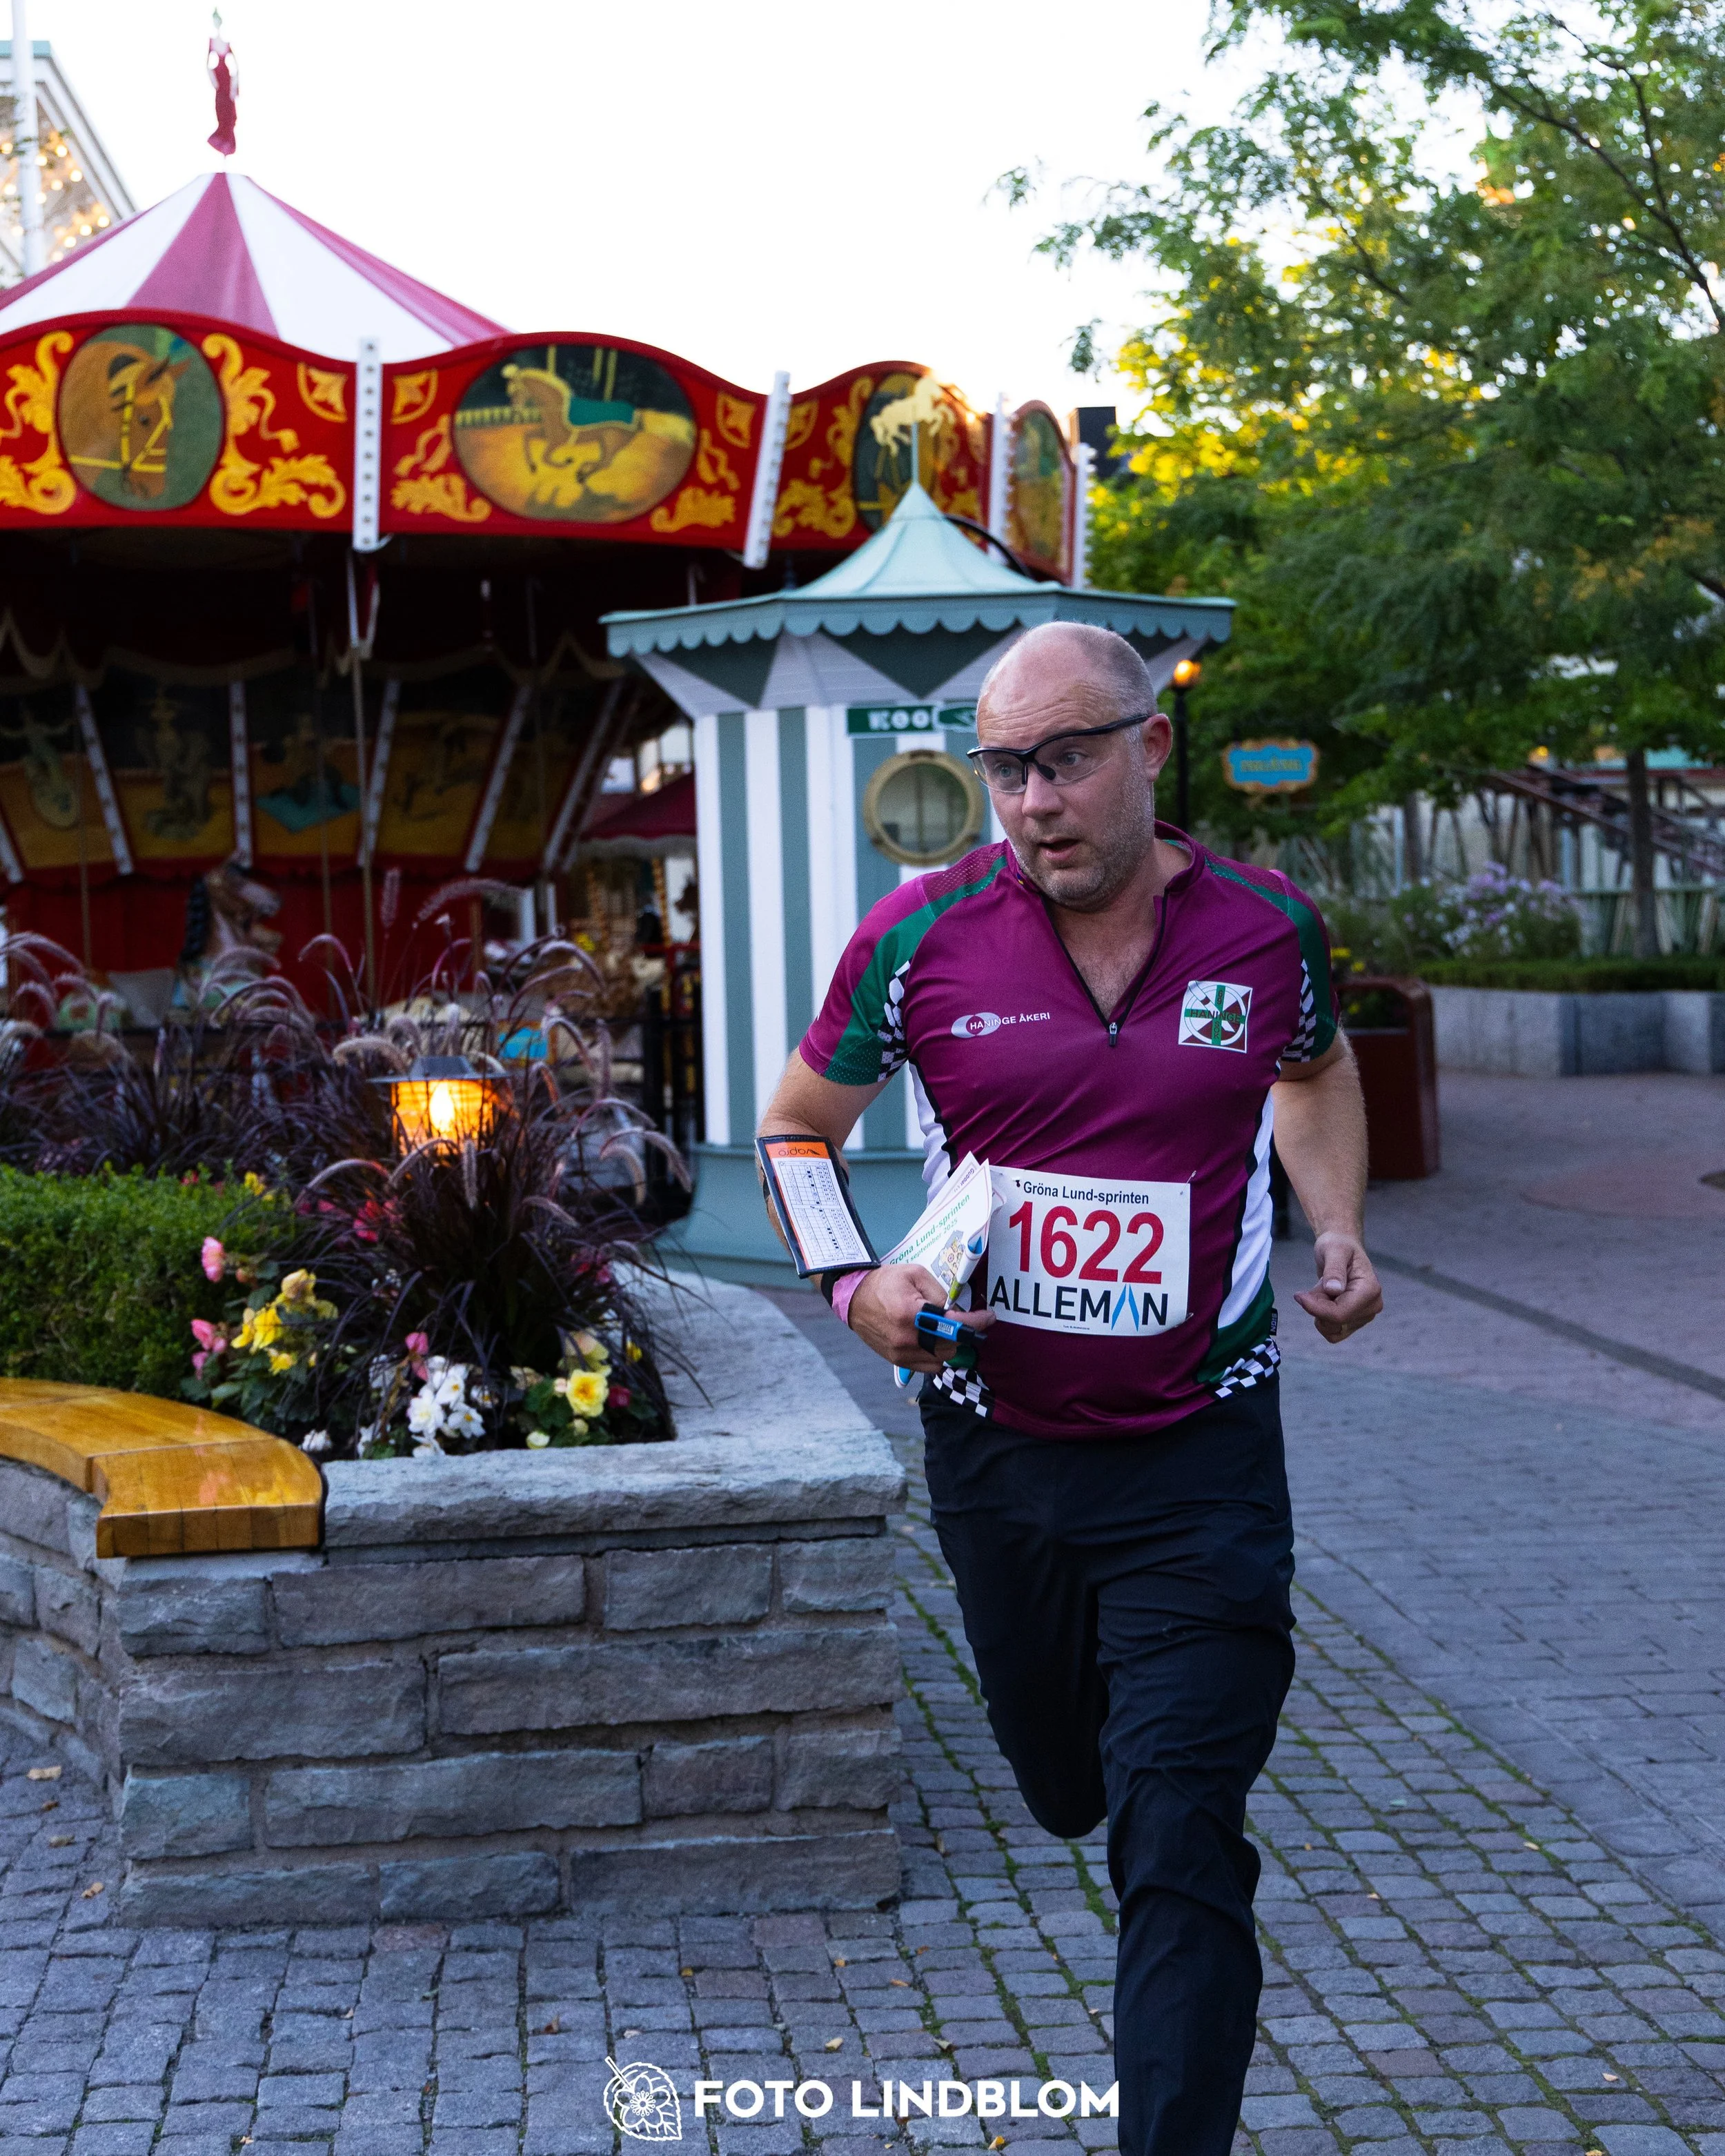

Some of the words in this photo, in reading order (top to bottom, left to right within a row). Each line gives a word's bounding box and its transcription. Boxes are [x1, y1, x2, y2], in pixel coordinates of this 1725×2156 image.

[970, 1016, 1017, 1030] HANINGE
[1019, 1011, 1051, 1023] ÅKERI
[1190, 1009, 1241, 1024] HANINGE
[1023, 1181, 1058, 1198] Gröna
[1062, 1185, 1150, 1205] Lund-sprinten
[910, 1233, 943, 1262] september
[943, 1218, 958, 1234] 2025
[915, 1194, 970, 1245] Lund-sprinten
[1009, 1200, 1164, 1284] 1622
[989, 1275, 1169, 1332] ALLEMAN
